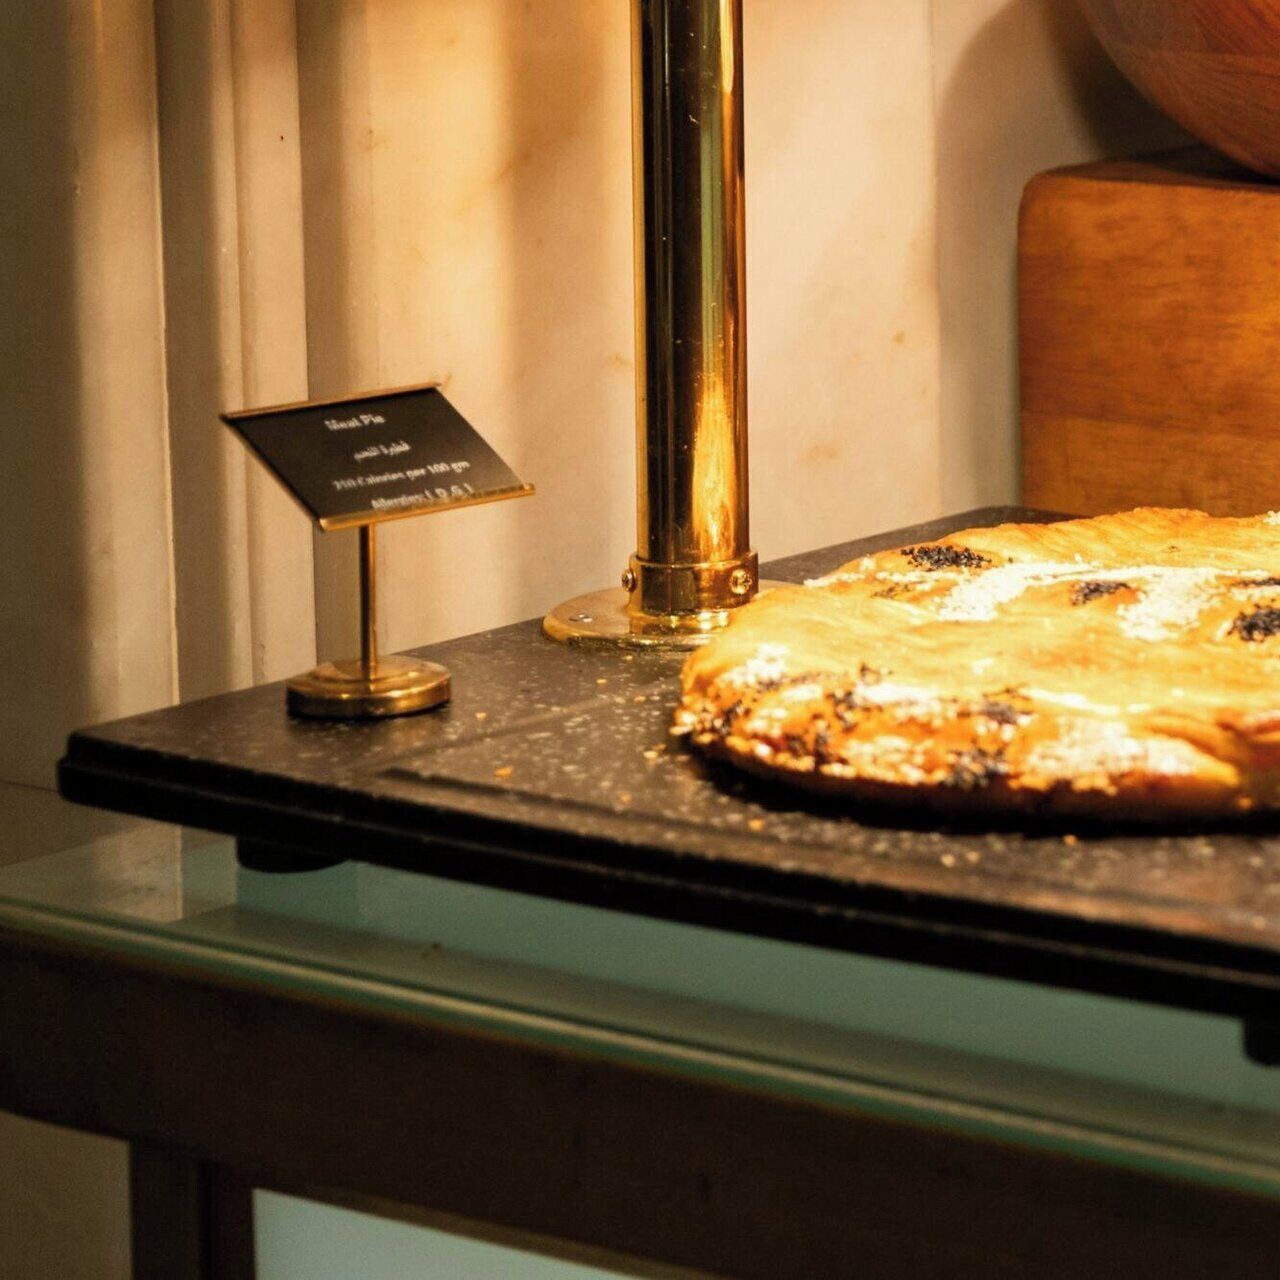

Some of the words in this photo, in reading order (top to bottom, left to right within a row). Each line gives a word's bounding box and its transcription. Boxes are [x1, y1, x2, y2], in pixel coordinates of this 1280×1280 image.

[360, 414, 386, 426] Pie
[405, 467, 426, 481] per
[427, 462, 451, 474] 100
[451, 460, 471, 473] gm
